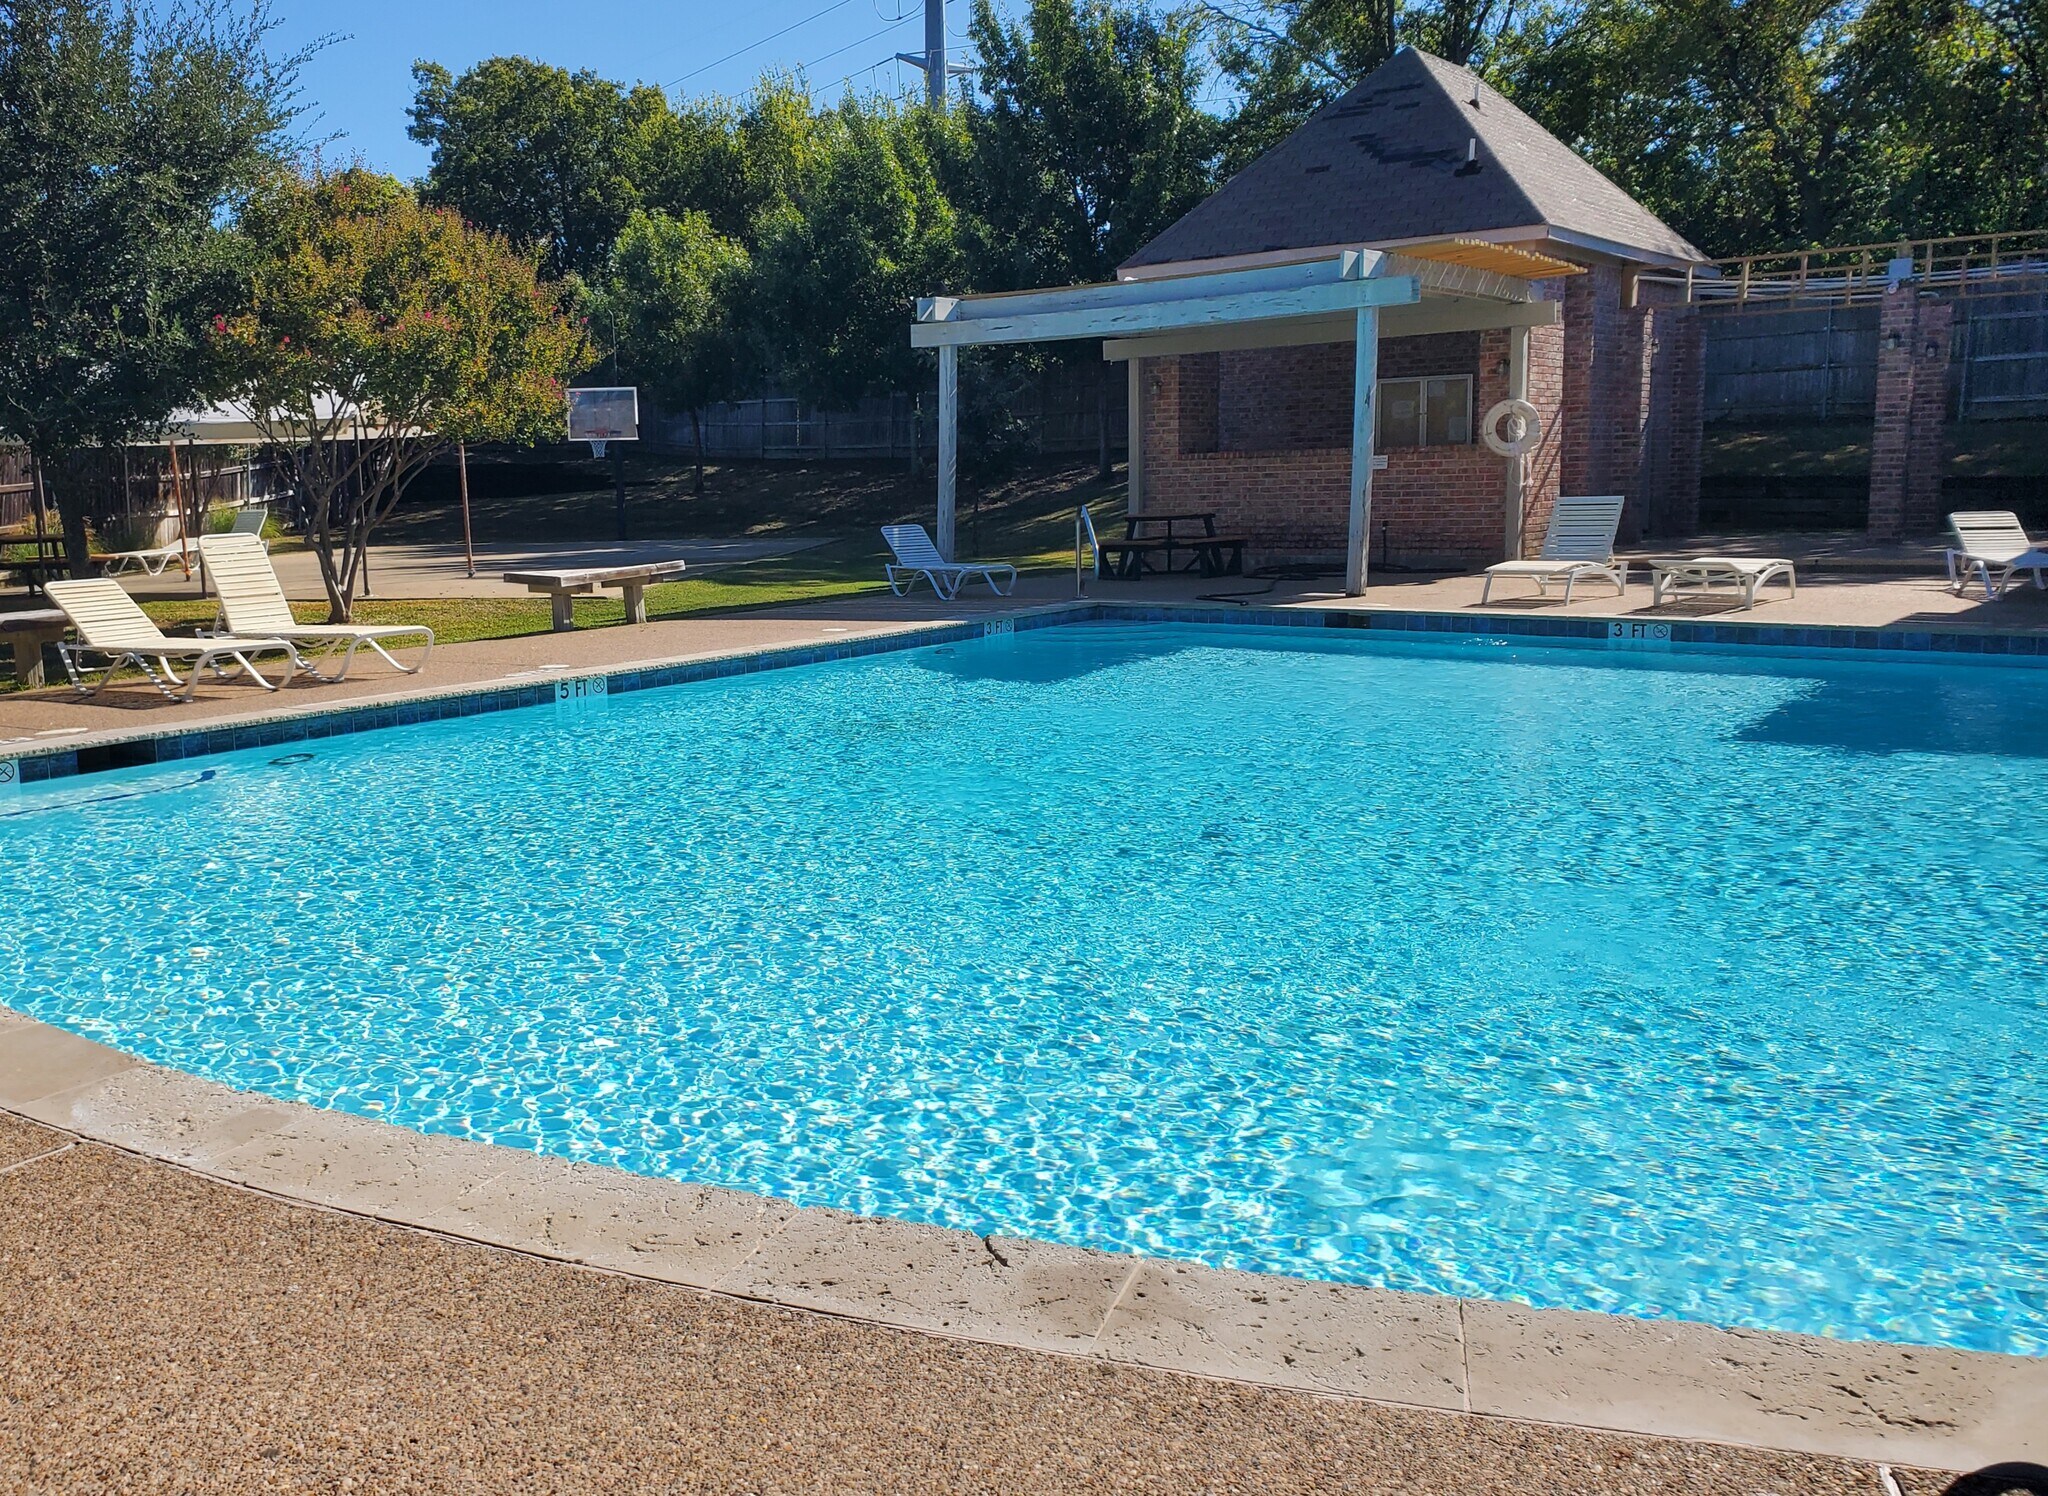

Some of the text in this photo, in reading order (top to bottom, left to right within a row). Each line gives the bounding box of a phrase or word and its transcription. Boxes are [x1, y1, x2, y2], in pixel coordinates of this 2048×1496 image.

[986, 620, 1003, 635] 3 FT
[1613, 622, 1647, 638] 3 FT
[560, 679, 588, 699] 5 FT
